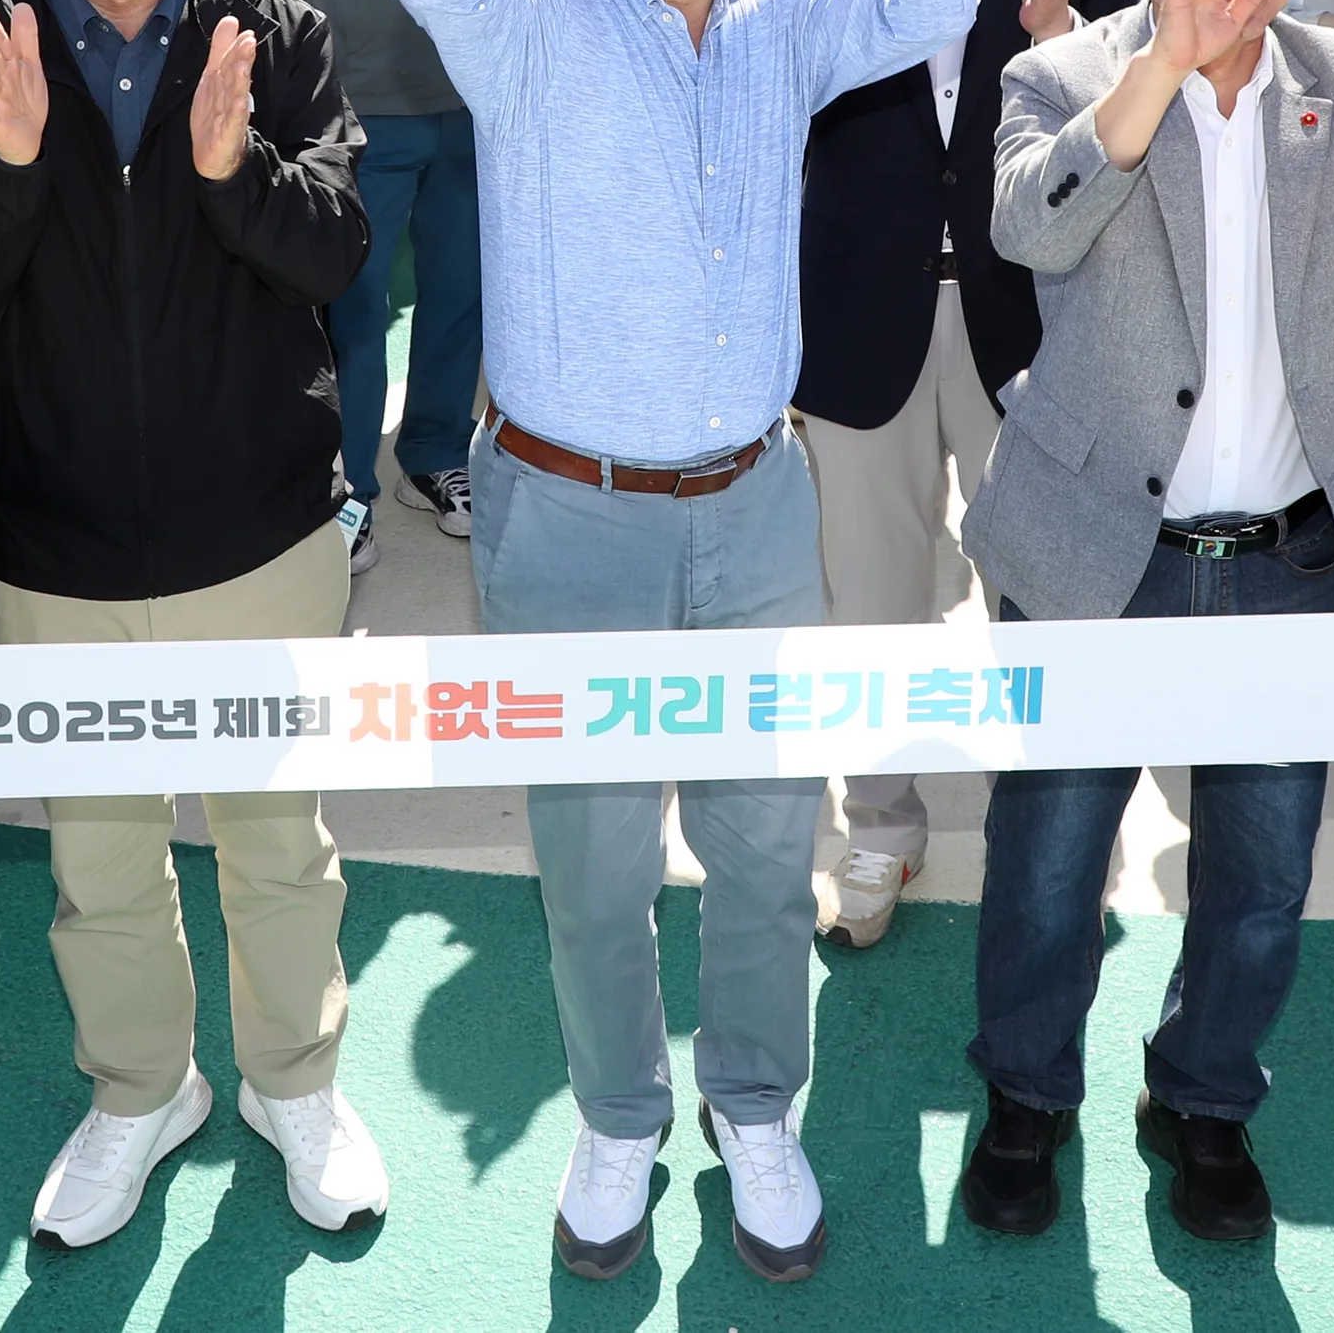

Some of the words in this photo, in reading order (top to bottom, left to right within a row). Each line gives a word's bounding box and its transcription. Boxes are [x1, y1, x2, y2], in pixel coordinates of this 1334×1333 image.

[212, 695, 331, 739] 제1회
[347, 678, 565, 743] 차없는
[585, 674, 726, 737] 거리
[747, 670, 886, 734] 걷기
[905, 666, 1045, 726] 축제
